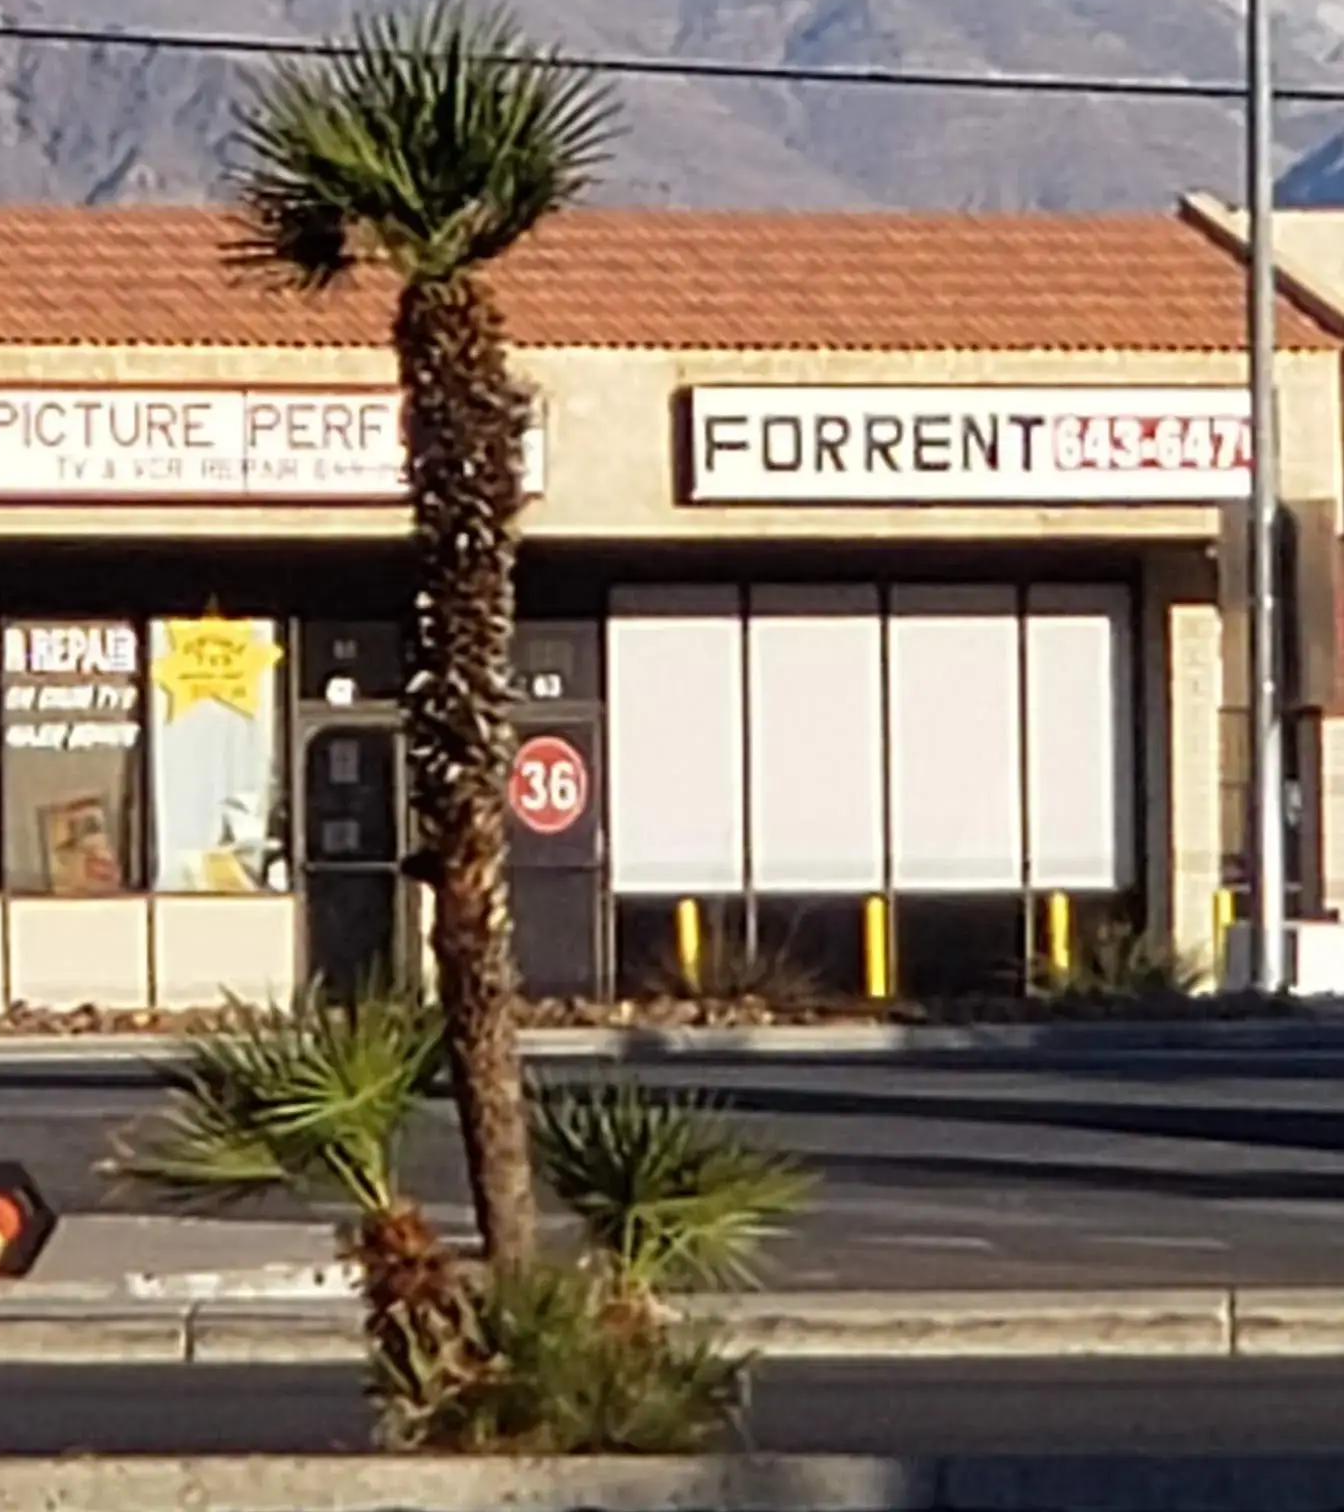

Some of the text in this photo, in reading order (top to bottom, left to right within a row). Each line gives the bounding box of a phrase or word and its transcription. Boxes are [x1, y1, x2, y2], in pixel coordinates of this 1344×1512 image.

[249, 401, 389, 450] PERF
[30, 627, 138, 672] REPAIR
[519, 760, 578, 812] 36
